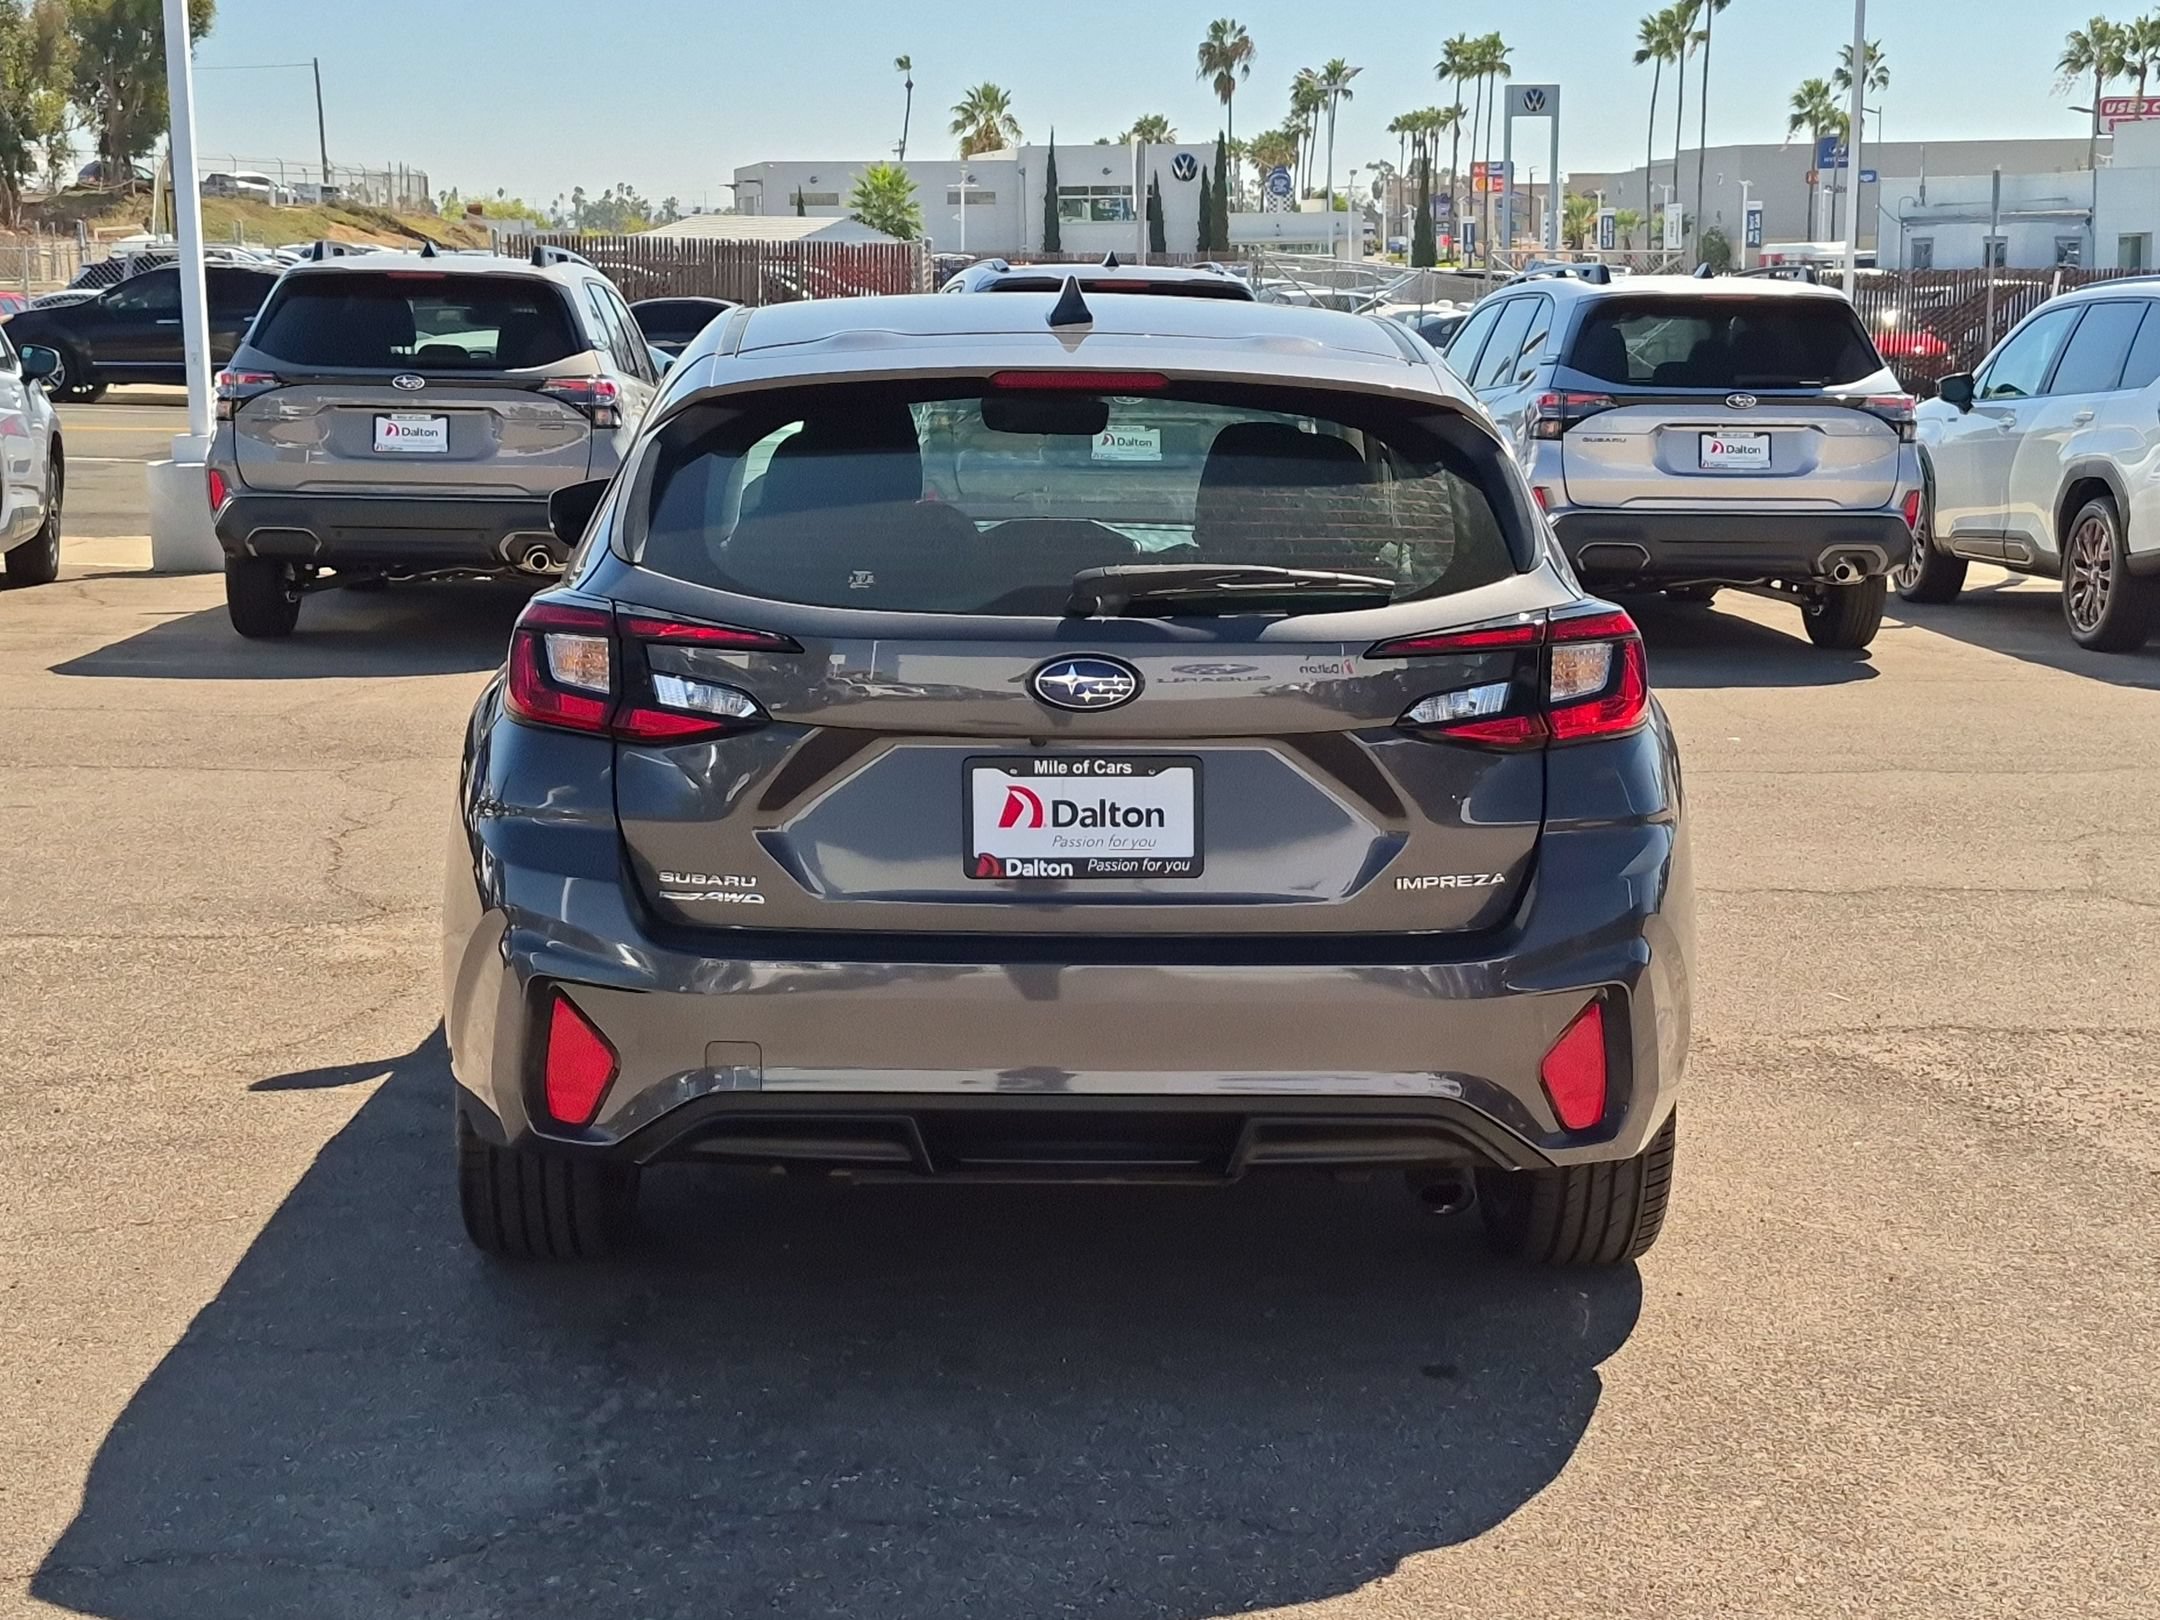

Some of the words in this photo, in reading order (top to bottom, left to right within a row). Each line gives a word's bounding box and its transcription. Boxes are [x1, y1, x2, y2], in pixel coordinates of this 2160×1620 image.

[2104, 101, 2149, 114] USED
[401, 426, 439, 437] Dalton
[1117, 436, 1153, 447] Dalton
[1726, 444, 1761, 454] Dalton
[1034, 760, 1067, 775] Mile
[1073, 760, 1089, 775] of
[1093, 760, 1133, 775] Cars
[1051, 798, 1165, 828] Dalton
[1052, 834, 1104, 849] Passion
[1108, 834, 1128, 849] for
[1131, 836, 1157, 850] you
[1006, 858, 1074, 878] Dalton
[1087, 858, 1140, 872] Passion
[1142, 858, 1163, 872] for
[1165, 860, 1191, 874] you
[659, 871, 757, 888] SUBARU
[1395, 872, 1506, 891] IMPREZA
